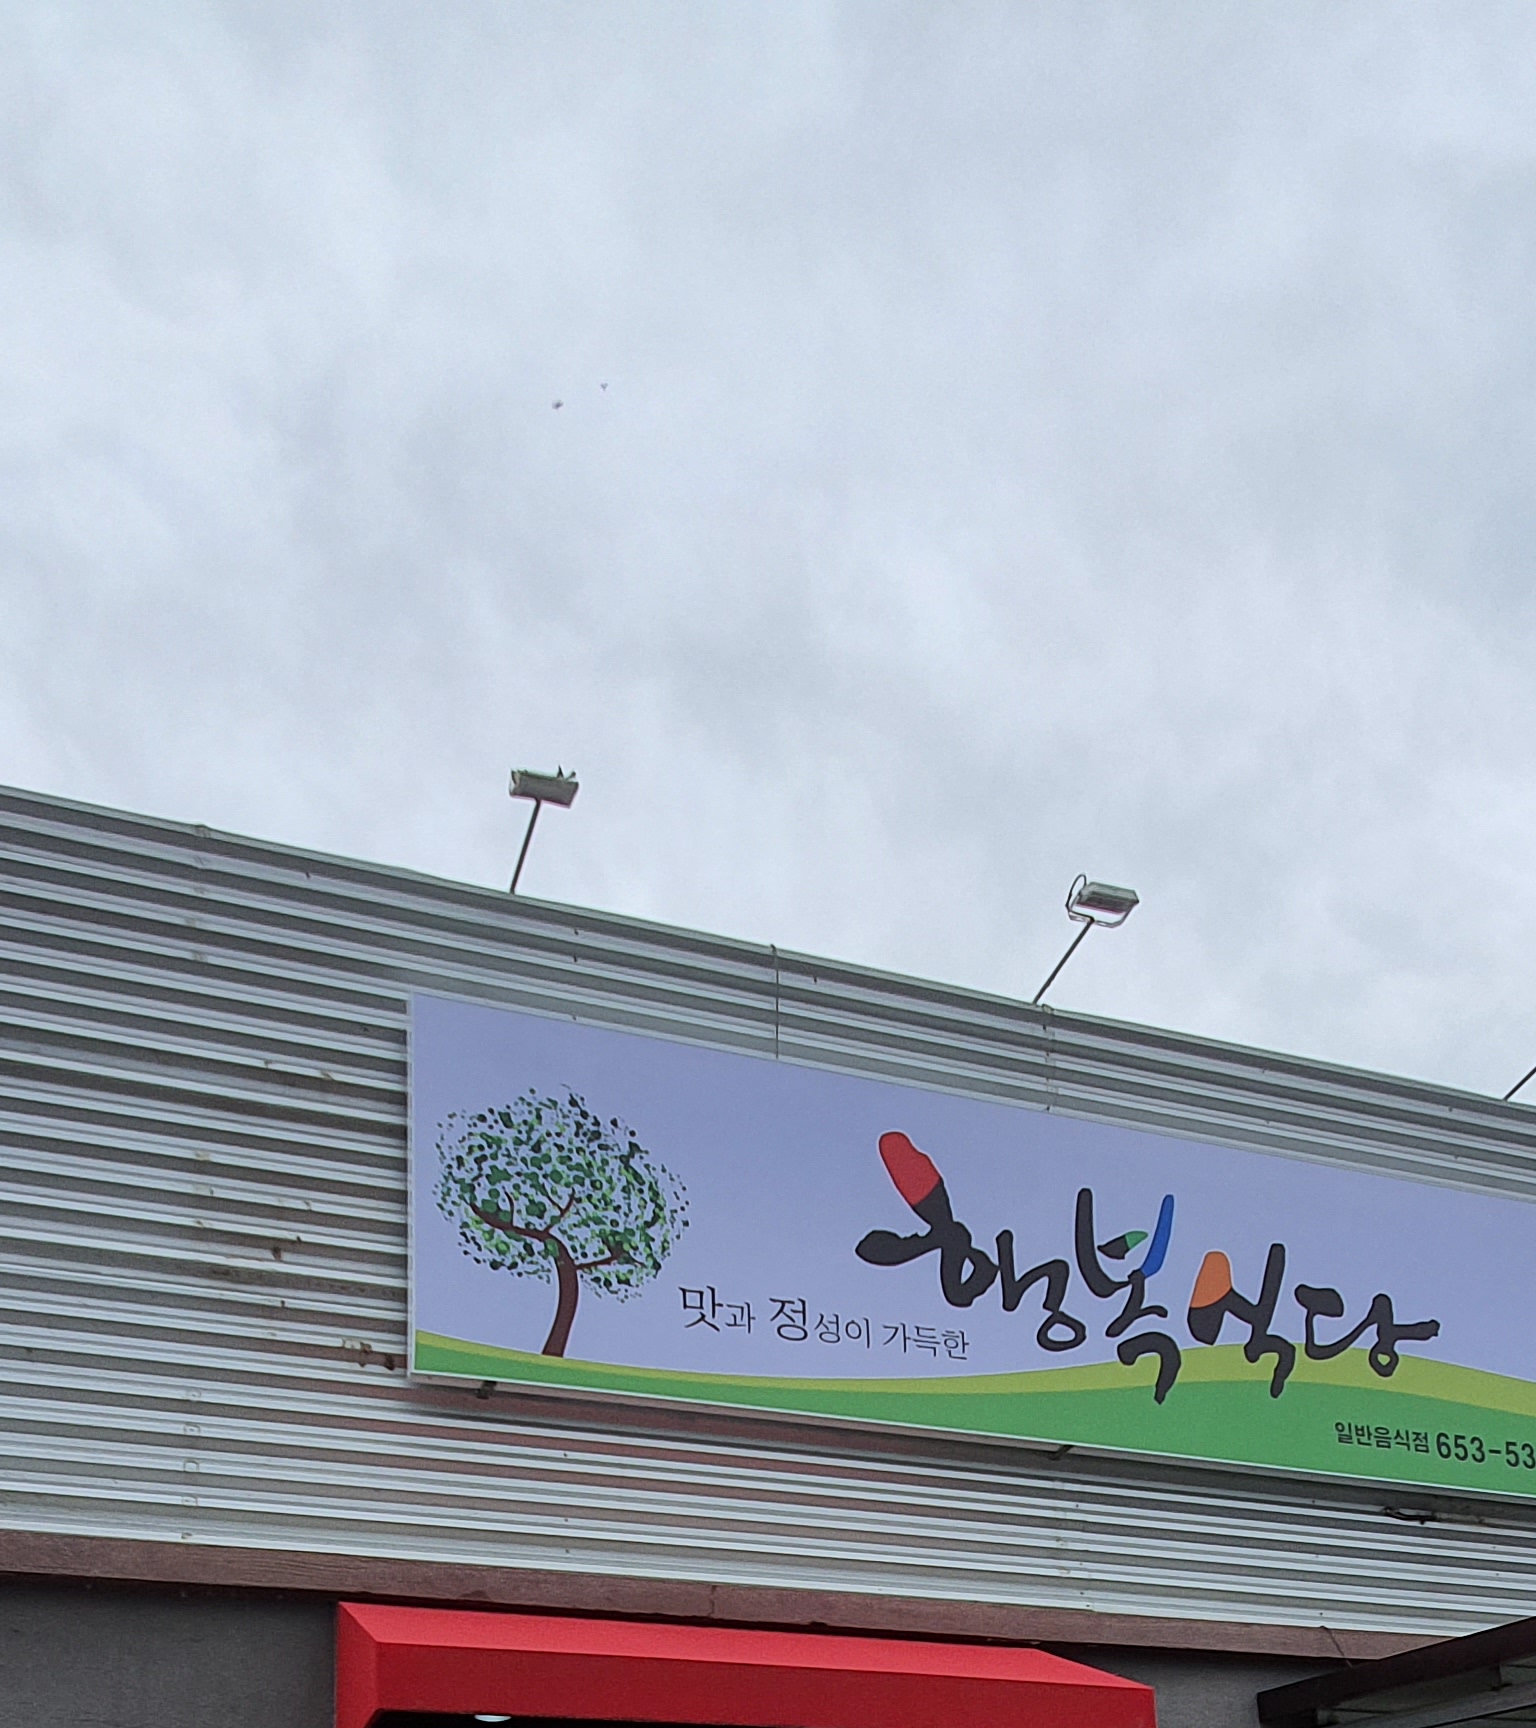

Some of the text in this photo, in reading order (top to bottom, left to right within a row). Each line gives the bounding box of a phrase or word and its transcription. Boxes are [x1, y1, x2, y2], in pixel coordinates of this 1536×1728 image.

[855, 1129, 1441, 1405] 행복식당
[678, 1285, 970, 1361] 맛과 정성이 가득한
[1334, 1421, 1430, 1453] 일반음식점
